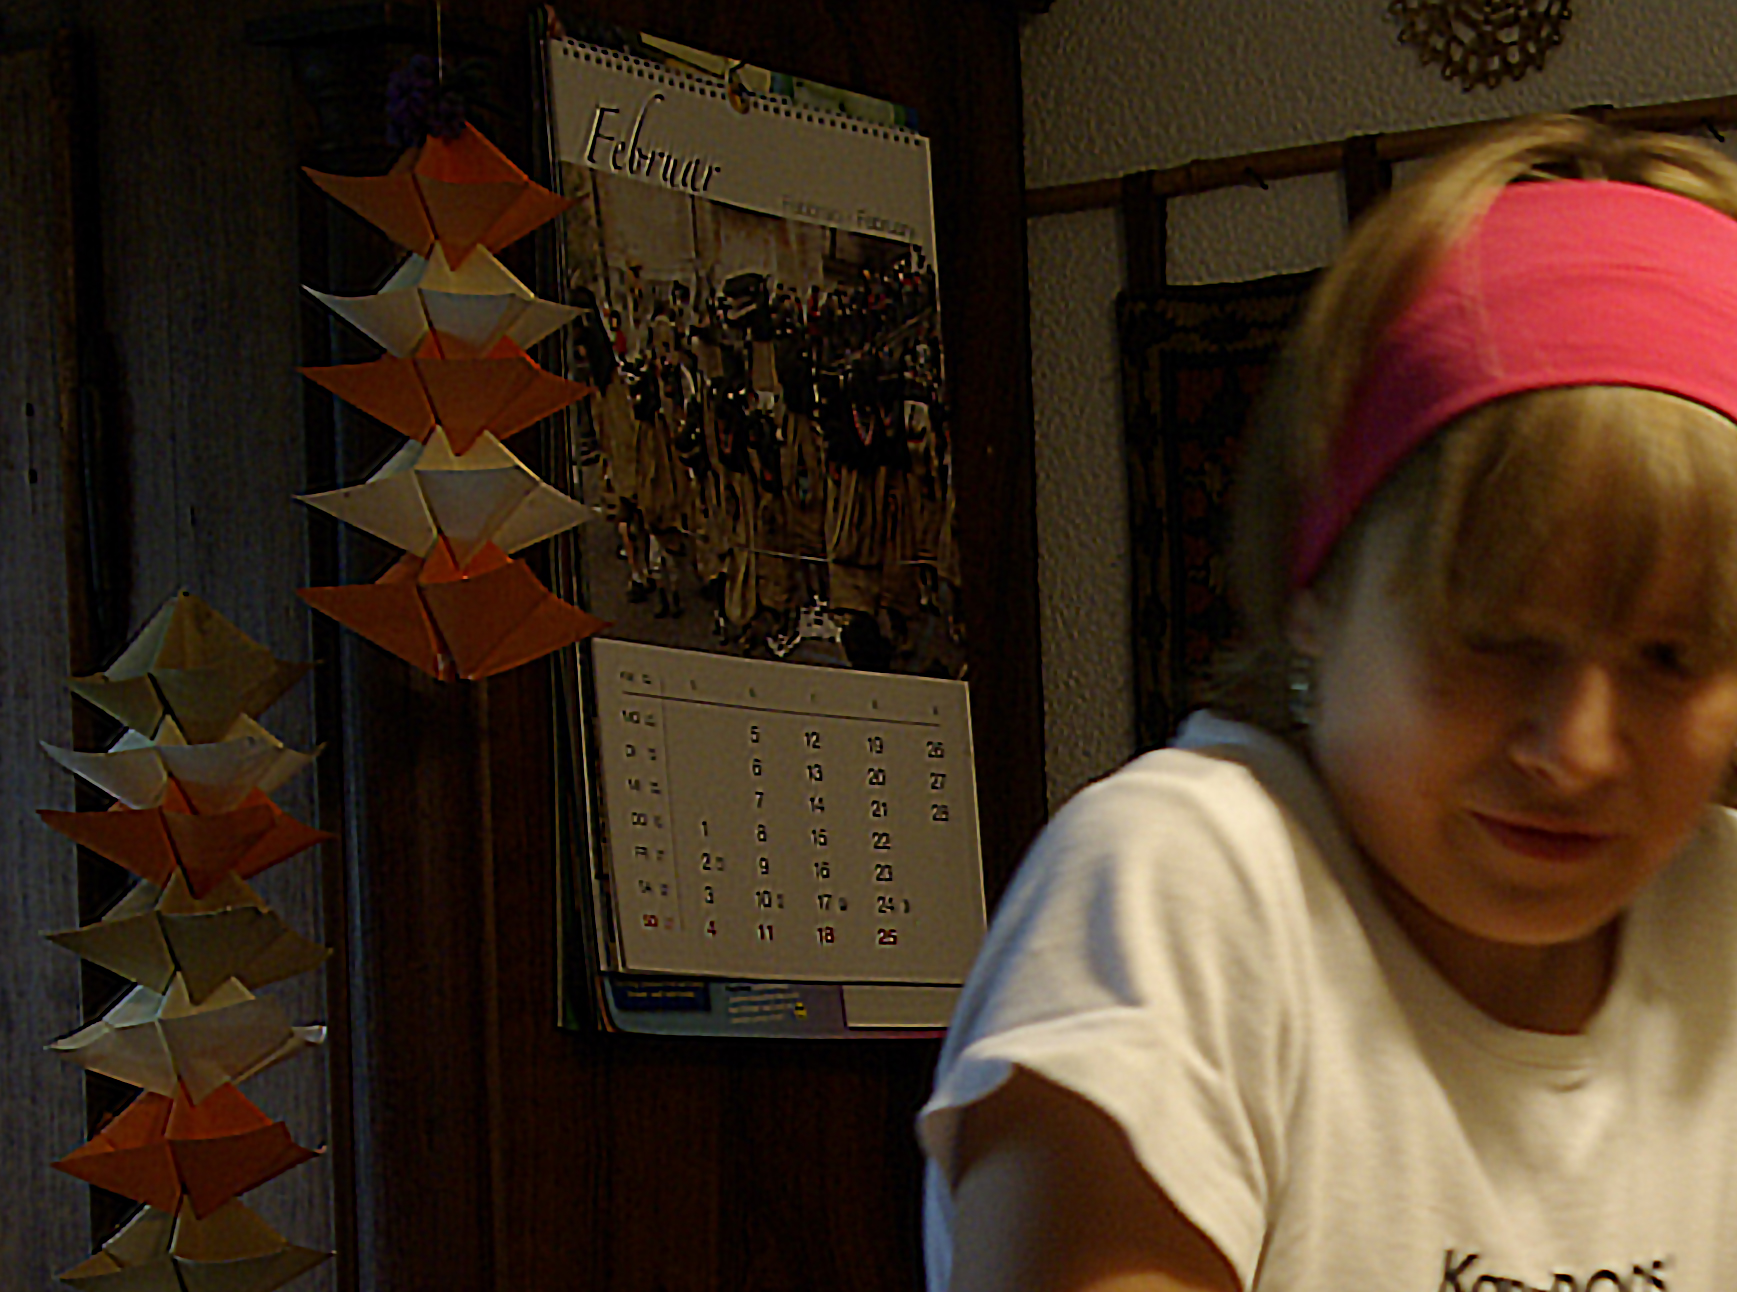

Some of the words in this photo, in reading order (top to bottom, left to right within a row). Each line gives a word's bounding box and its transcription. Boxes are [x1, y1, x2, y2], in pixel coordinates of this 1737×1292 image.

[586, 93, 721, 192] Februar
[751, 726, 760, 743] 5
[805, 732, 820, 749] 12
[753, 759, 762, 776] 6
[807, 764, 823, 781] 13
[868, 768, 886, 785] 20
[930, 773, 946, 789] 27
[755, 792, 764, 808] 7
[871, 800, 887, 817] 21
[702, 821, 708, 836] 1
[872, 832, 891, 849] 22
[701, 853, 711, 870] 2
[759, 857, 769, 874] 9
[875, 864, 893, 881] 23
[705, 886, 714, 904] 3
[756, 891, 772, 907] 10
[818, 894, 832, 910] 17
[877, 896, 895, 913] 24
[759, 924, 773, 941] 11
[878, 929, 898, 945] 25
